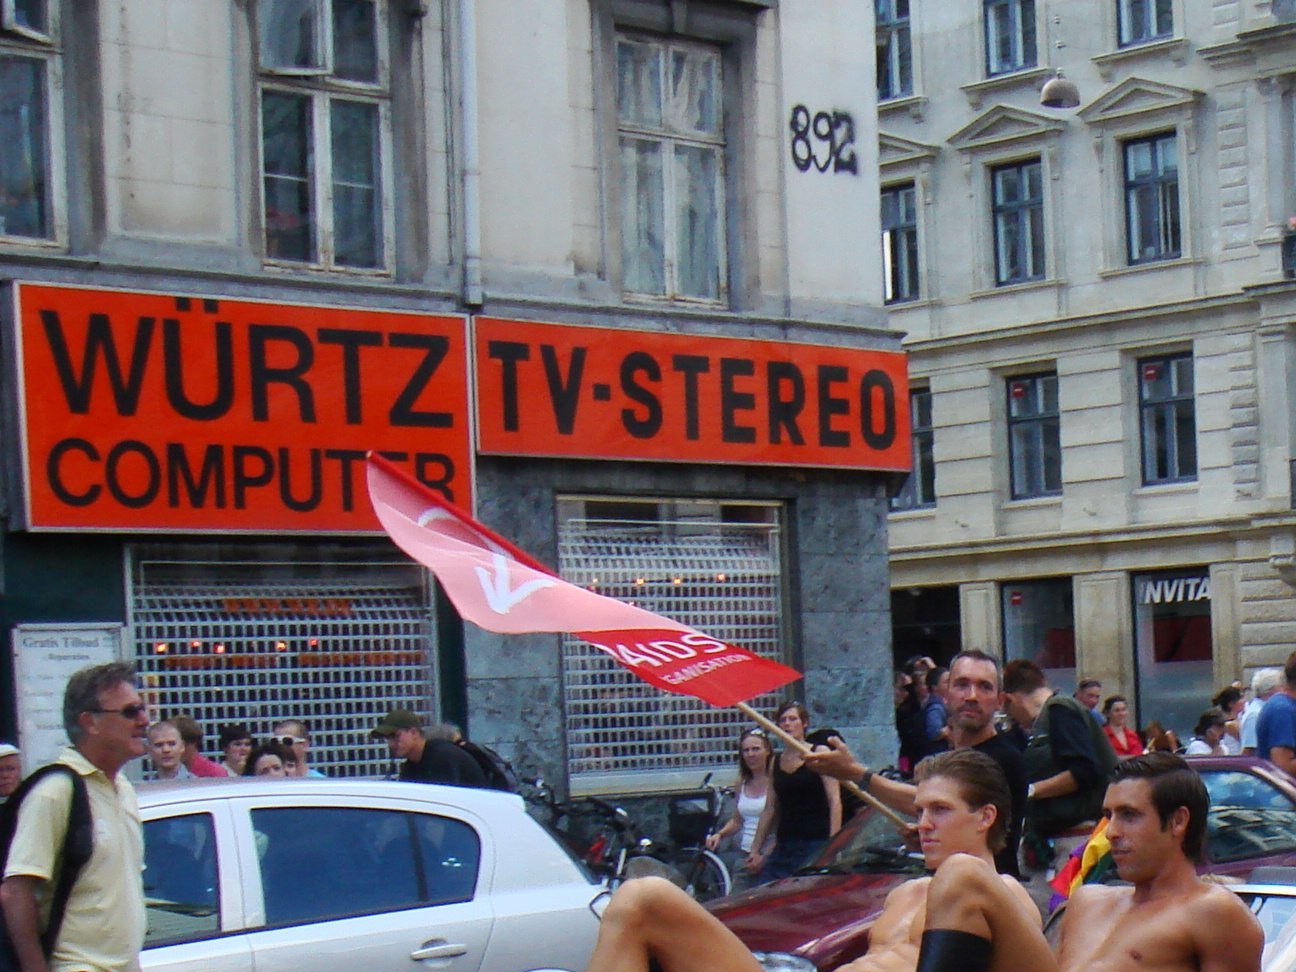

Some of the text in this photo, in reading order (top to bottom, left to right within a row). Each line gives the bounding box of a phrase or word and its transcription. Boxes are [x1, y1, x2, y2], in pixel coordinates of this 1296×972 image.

[790, 104, 858, 175] 892
[39, 297, 453, 428] WÜRTZ
[488, 341, 897, 450] TV-STEREO
[616, 633, 728, 668] AIDS
